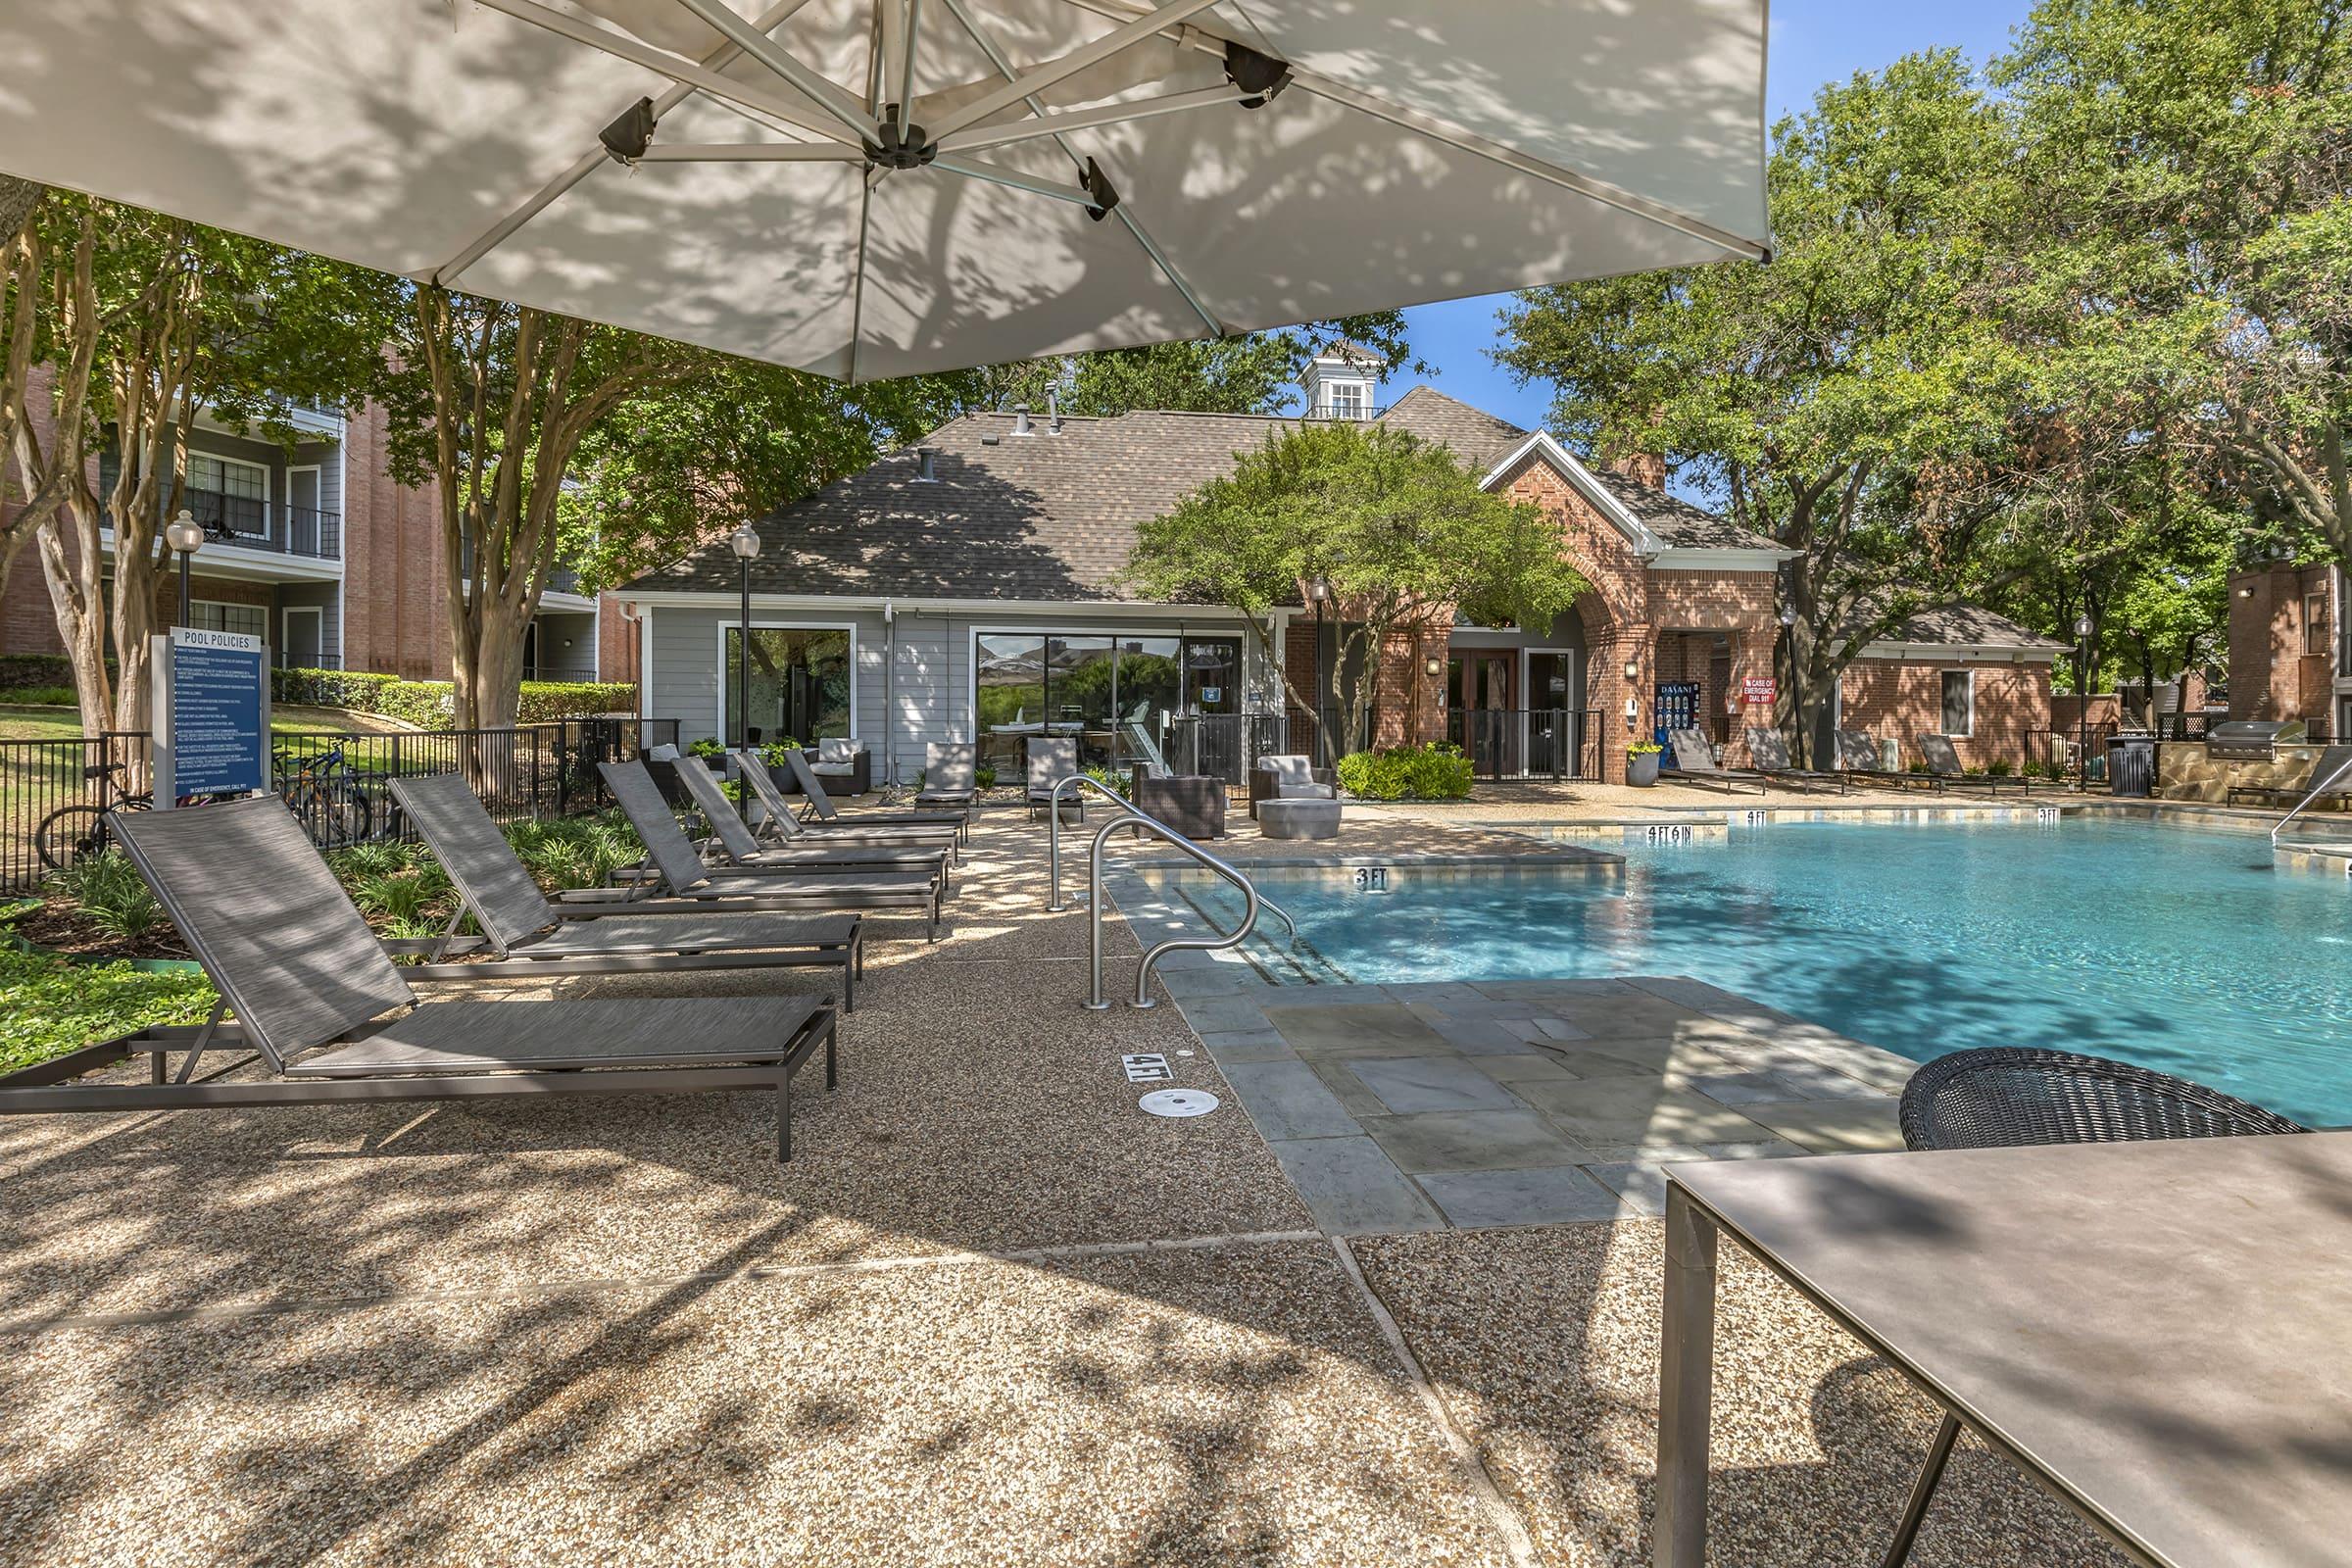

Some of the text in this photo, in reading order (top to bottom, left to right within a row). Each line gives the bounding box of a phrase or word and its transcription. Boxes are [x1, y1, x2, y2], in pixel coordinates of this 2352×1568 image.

[184, 631, 250, 648] POOL POLICIES
[1661, 685, 1691, 695] DASANI
[1747, 810, 1765, 823] 4 FT
[1648, 826, 1690, 840] 4 FT 6 IN
[1356, 868, 1387, 884] 3 FT
[1126, 1056, 1170, 1079] 4 FT
